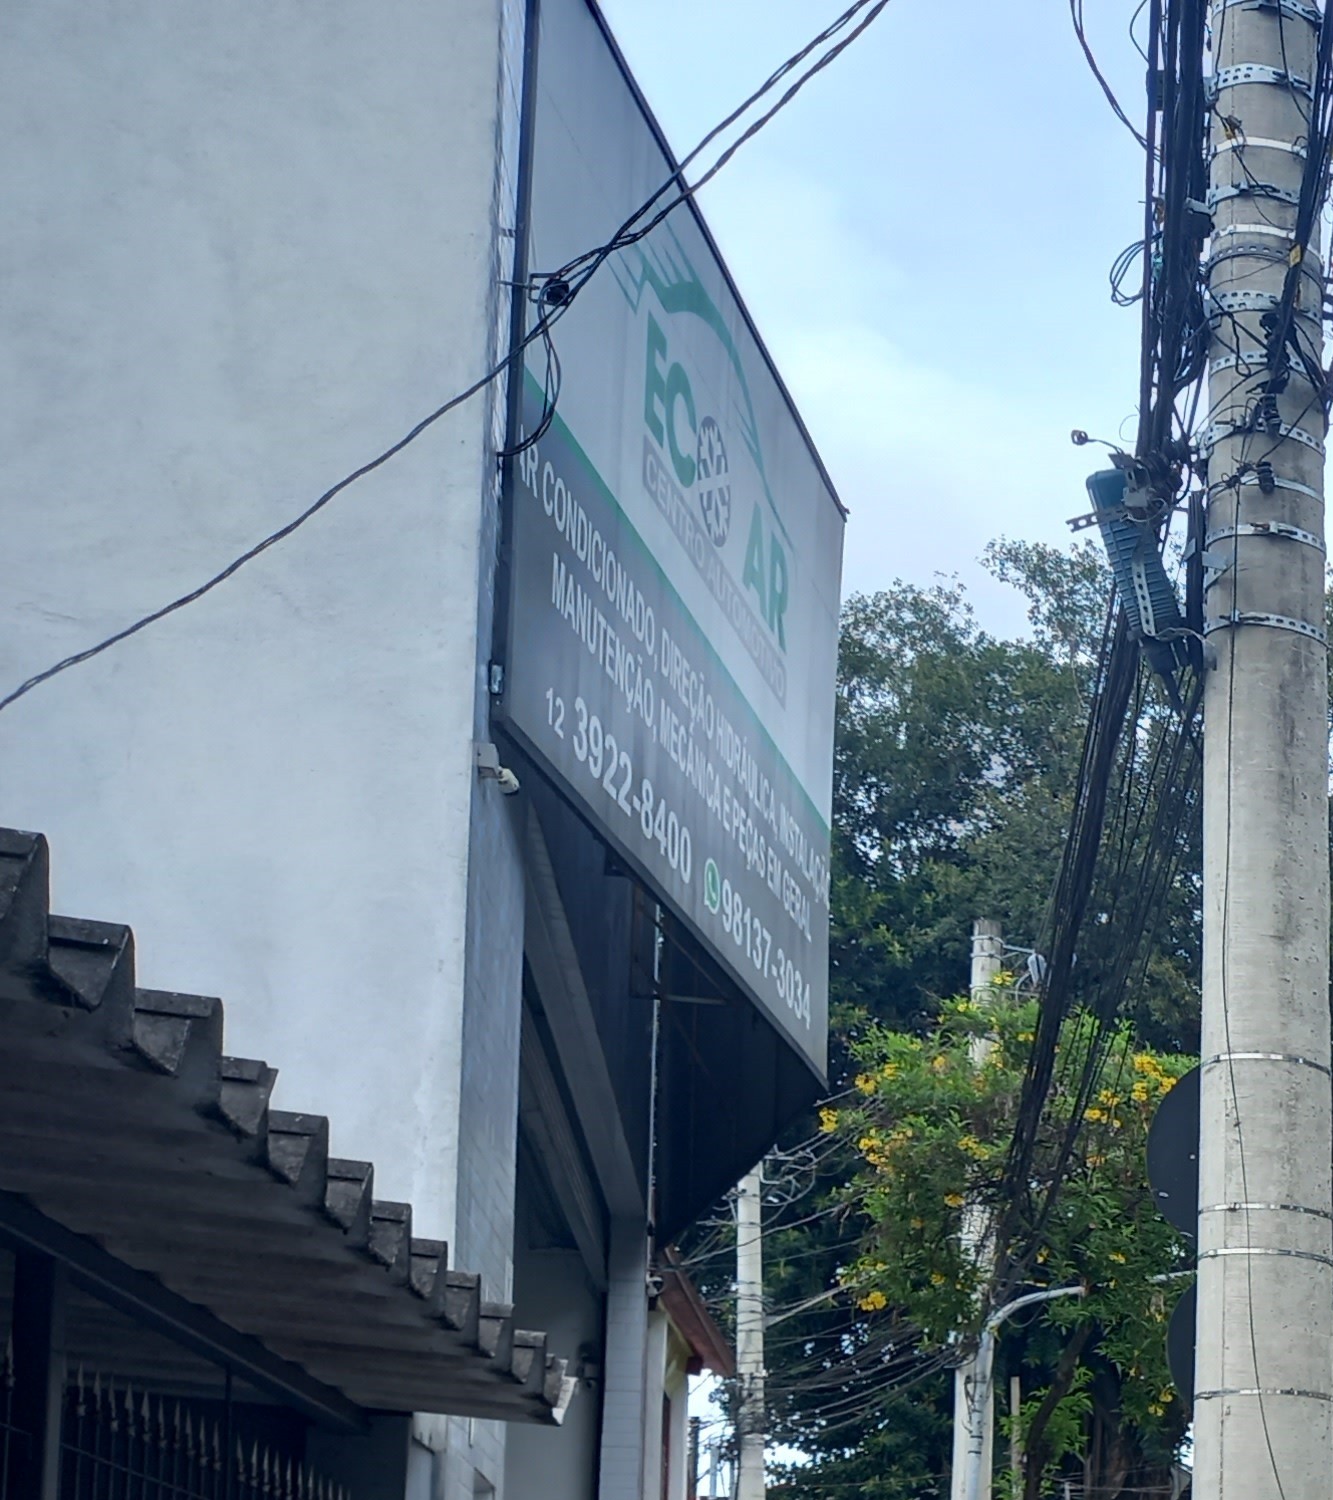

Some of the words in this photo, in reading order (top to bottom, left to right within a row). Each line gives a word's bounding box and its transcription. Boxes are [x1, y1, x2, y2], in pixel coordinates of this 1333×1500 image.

[543, 461, 658, 672] CONDICIONADO,
[661, 628, 714, 740] DIREÇÃO
[716, 707, 778, 840] HIDRÁULICA,
[551, 552, 657, 742] MANUTENÇÃO,
[660, 698, 721, 820] MECÂNICA
[722, 785, 731, 832] E
[732, 797, 766, 878] PEÇAS
[767, 846, 782, 900] EM
[782, 869, 812, 943] GERAL
[646, 453, 705, 568] CENTRO
[707, 560, 786, 698] AUTOMOTIVO
[546, 687, 565, 739] 12
[573, 697, 692, 884] 3922-8400
[722, 879, 811, 1030] 98137-3034
